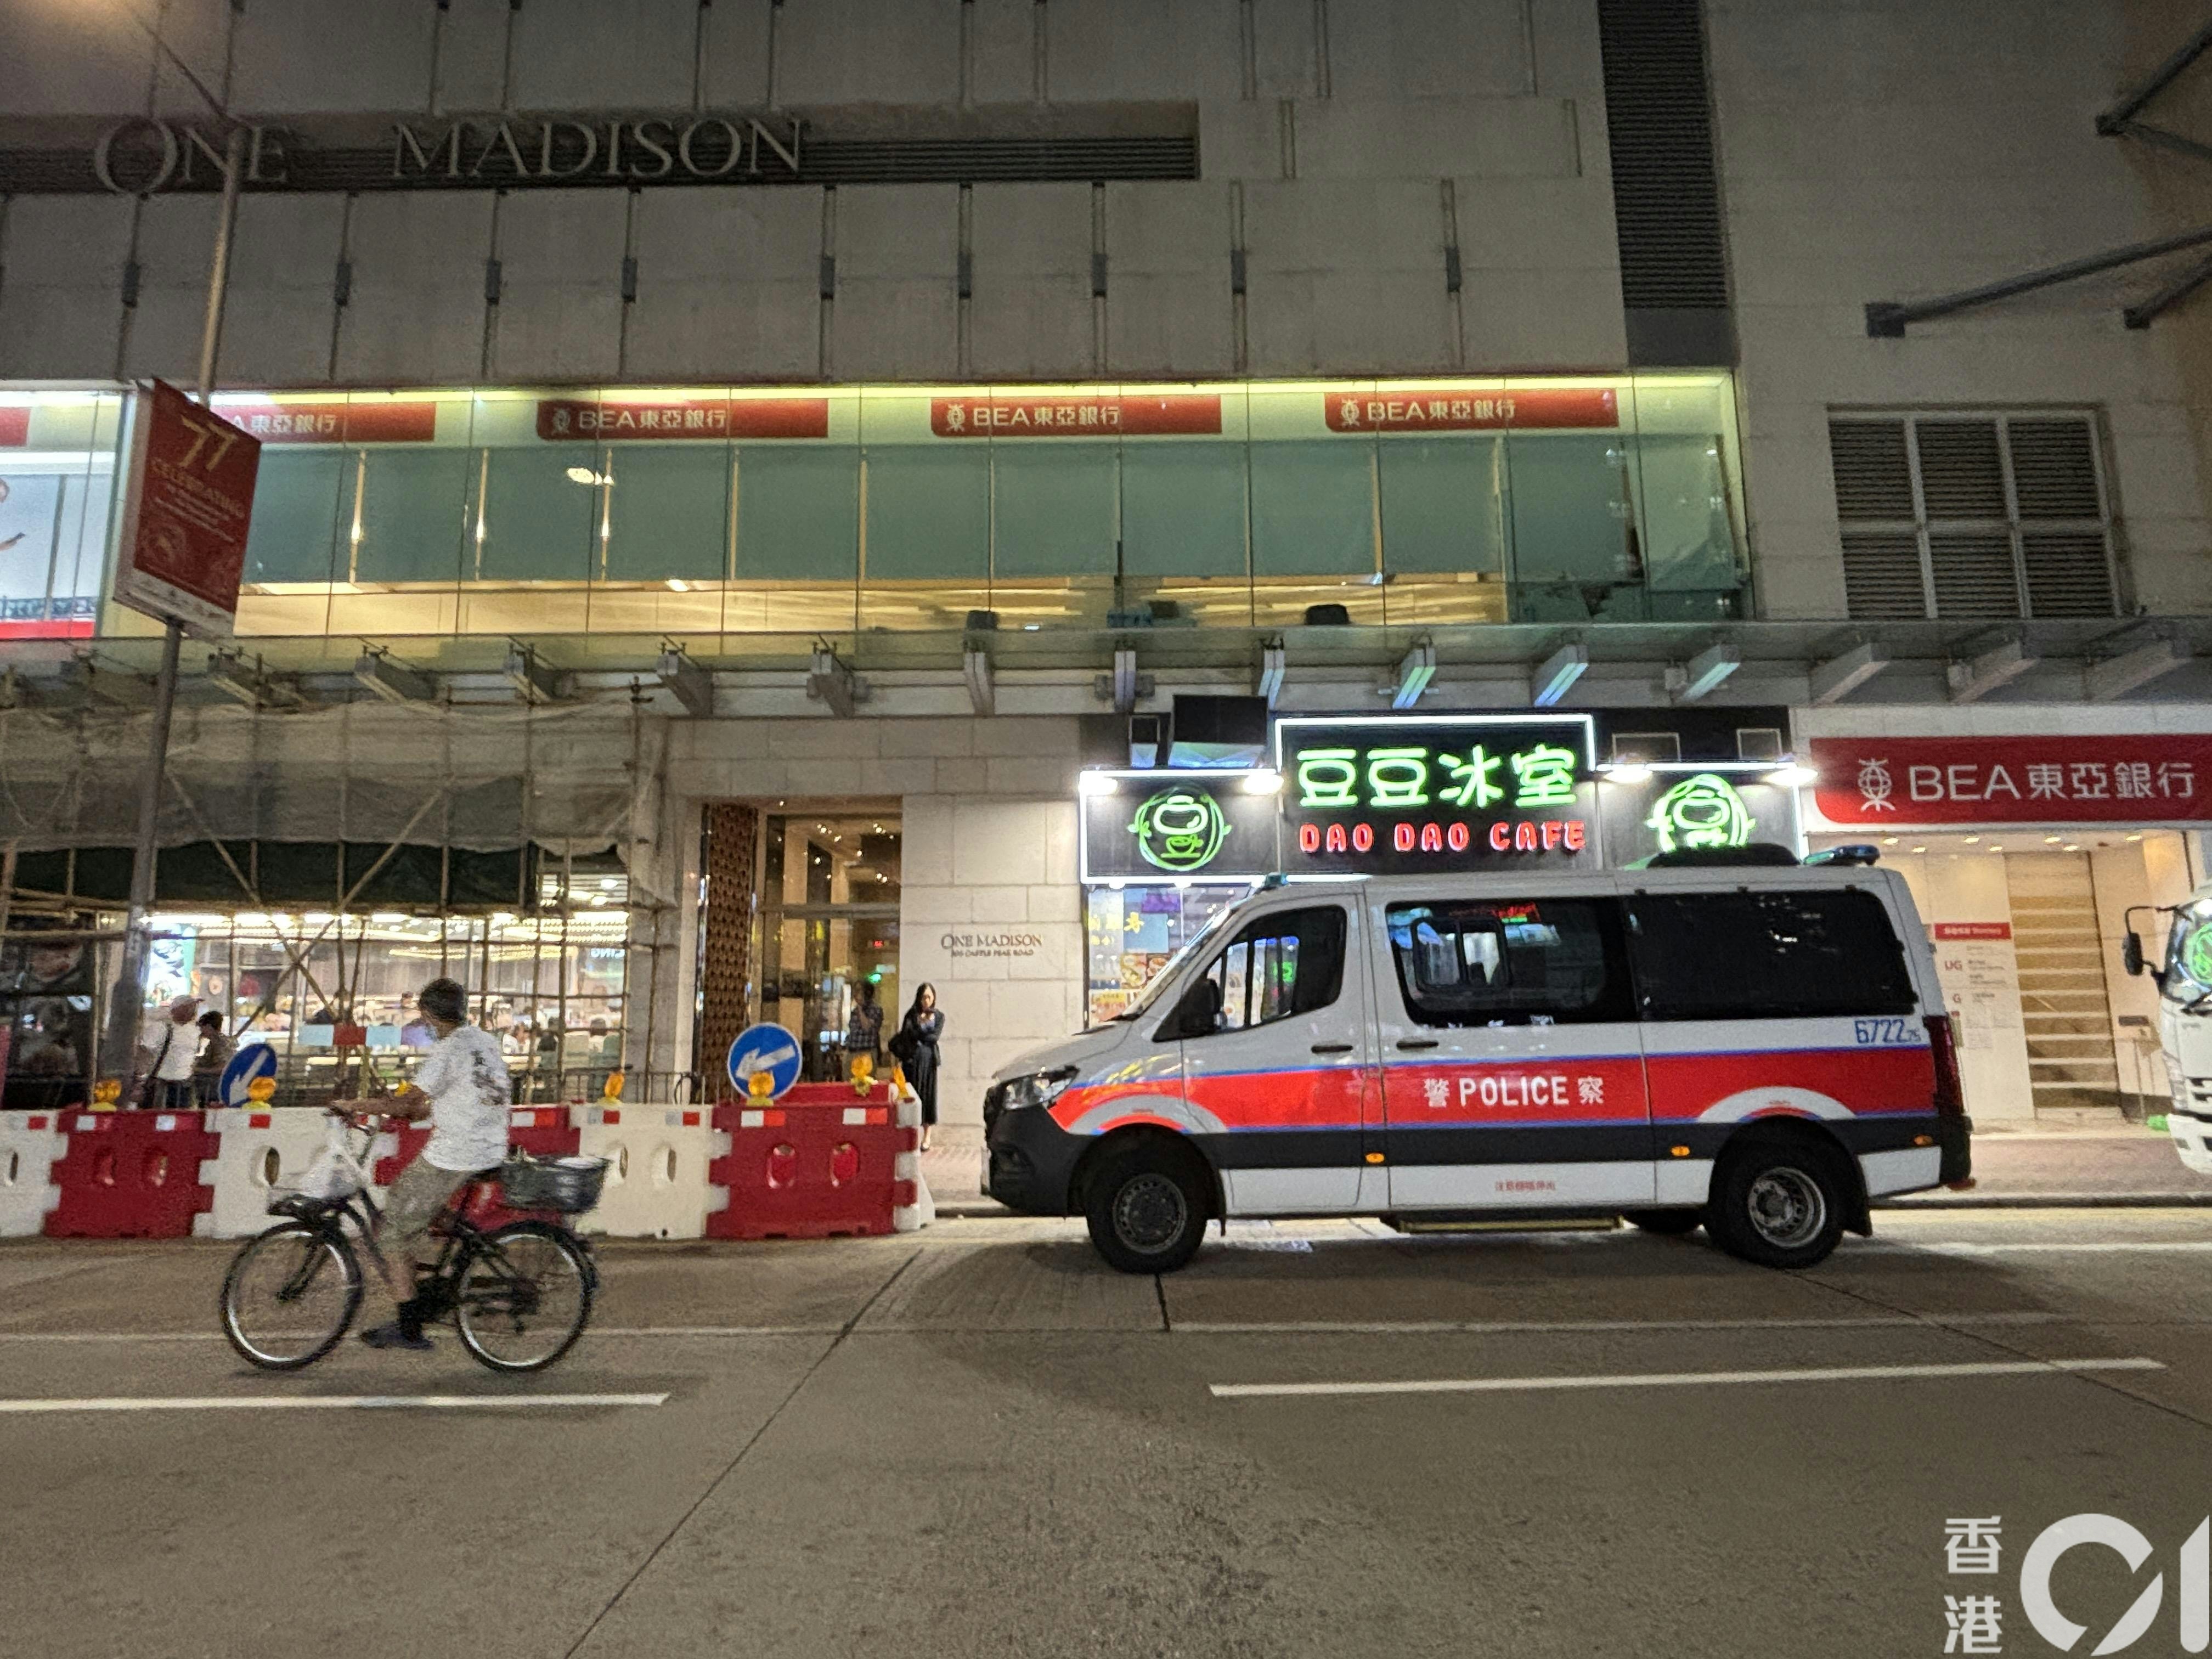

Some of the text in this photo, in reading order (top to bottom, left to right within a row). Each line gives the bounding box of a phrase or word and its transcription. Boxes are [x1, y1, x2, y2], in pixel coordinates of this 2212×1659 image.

[94, 114, 803, 194] ONE MADISON
[251, 414, 337, 433] 東亞銀行
[579, 409, 726, 430] BEA 東亞銀行
[973, 406, 1119, 426] BEA 東亞銀行
[1367, 399, 1516, 421] BEA 東亞銀行
[181, 413, 238, 472] 77
[1296, 744, 1577, 808] 豆豆冰室
[1908, 762, 2195, 802] BEA 東亞銀行
[1299, 821, 1585, 853] DAO DAO CAFE
[940, 933, 1042, 950] ONE MADISON
[1854, 1018, 1907, 1043] 6722
[1423, 1075, 1604, 1108] 警 POLICE 察
